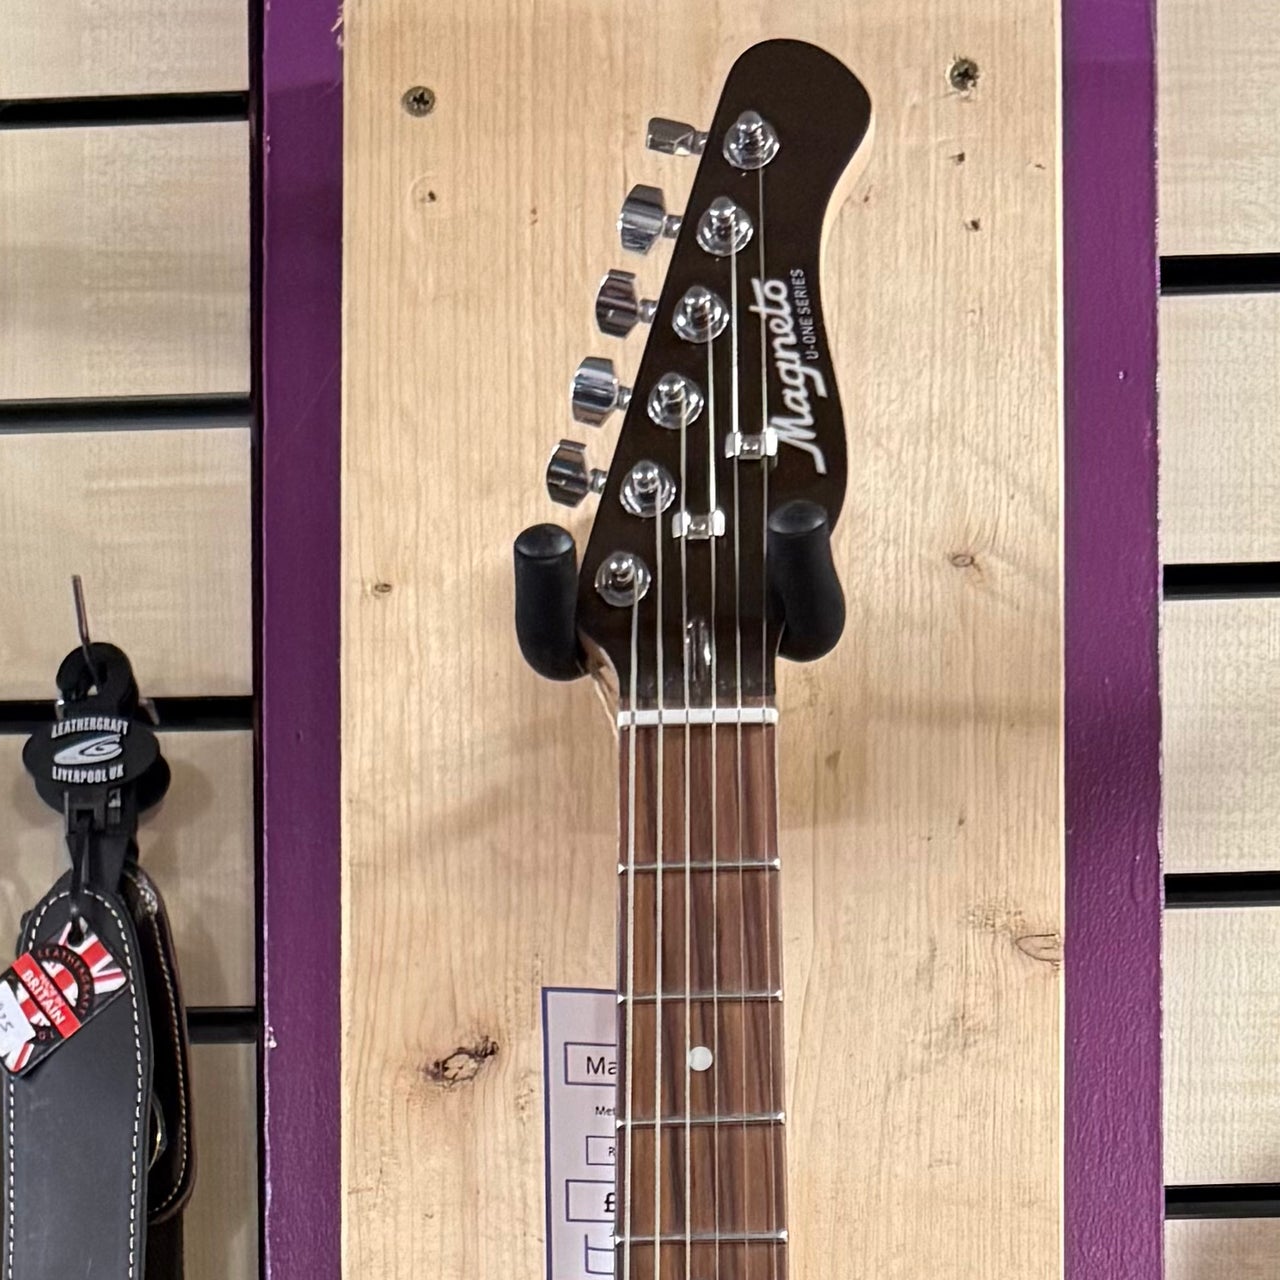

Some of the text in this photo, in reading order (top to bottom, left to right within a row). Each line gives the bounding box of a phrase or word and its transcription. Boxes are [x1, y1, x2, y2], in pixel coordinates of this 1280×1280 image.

[790, 268, 819, 361] U-ONE SERIES
[749, 277, 828, 474] Magneto
[52, 764, 124, 783] LIVERPOOL UK
[22, 969, 66, 1024] BRITAIN
